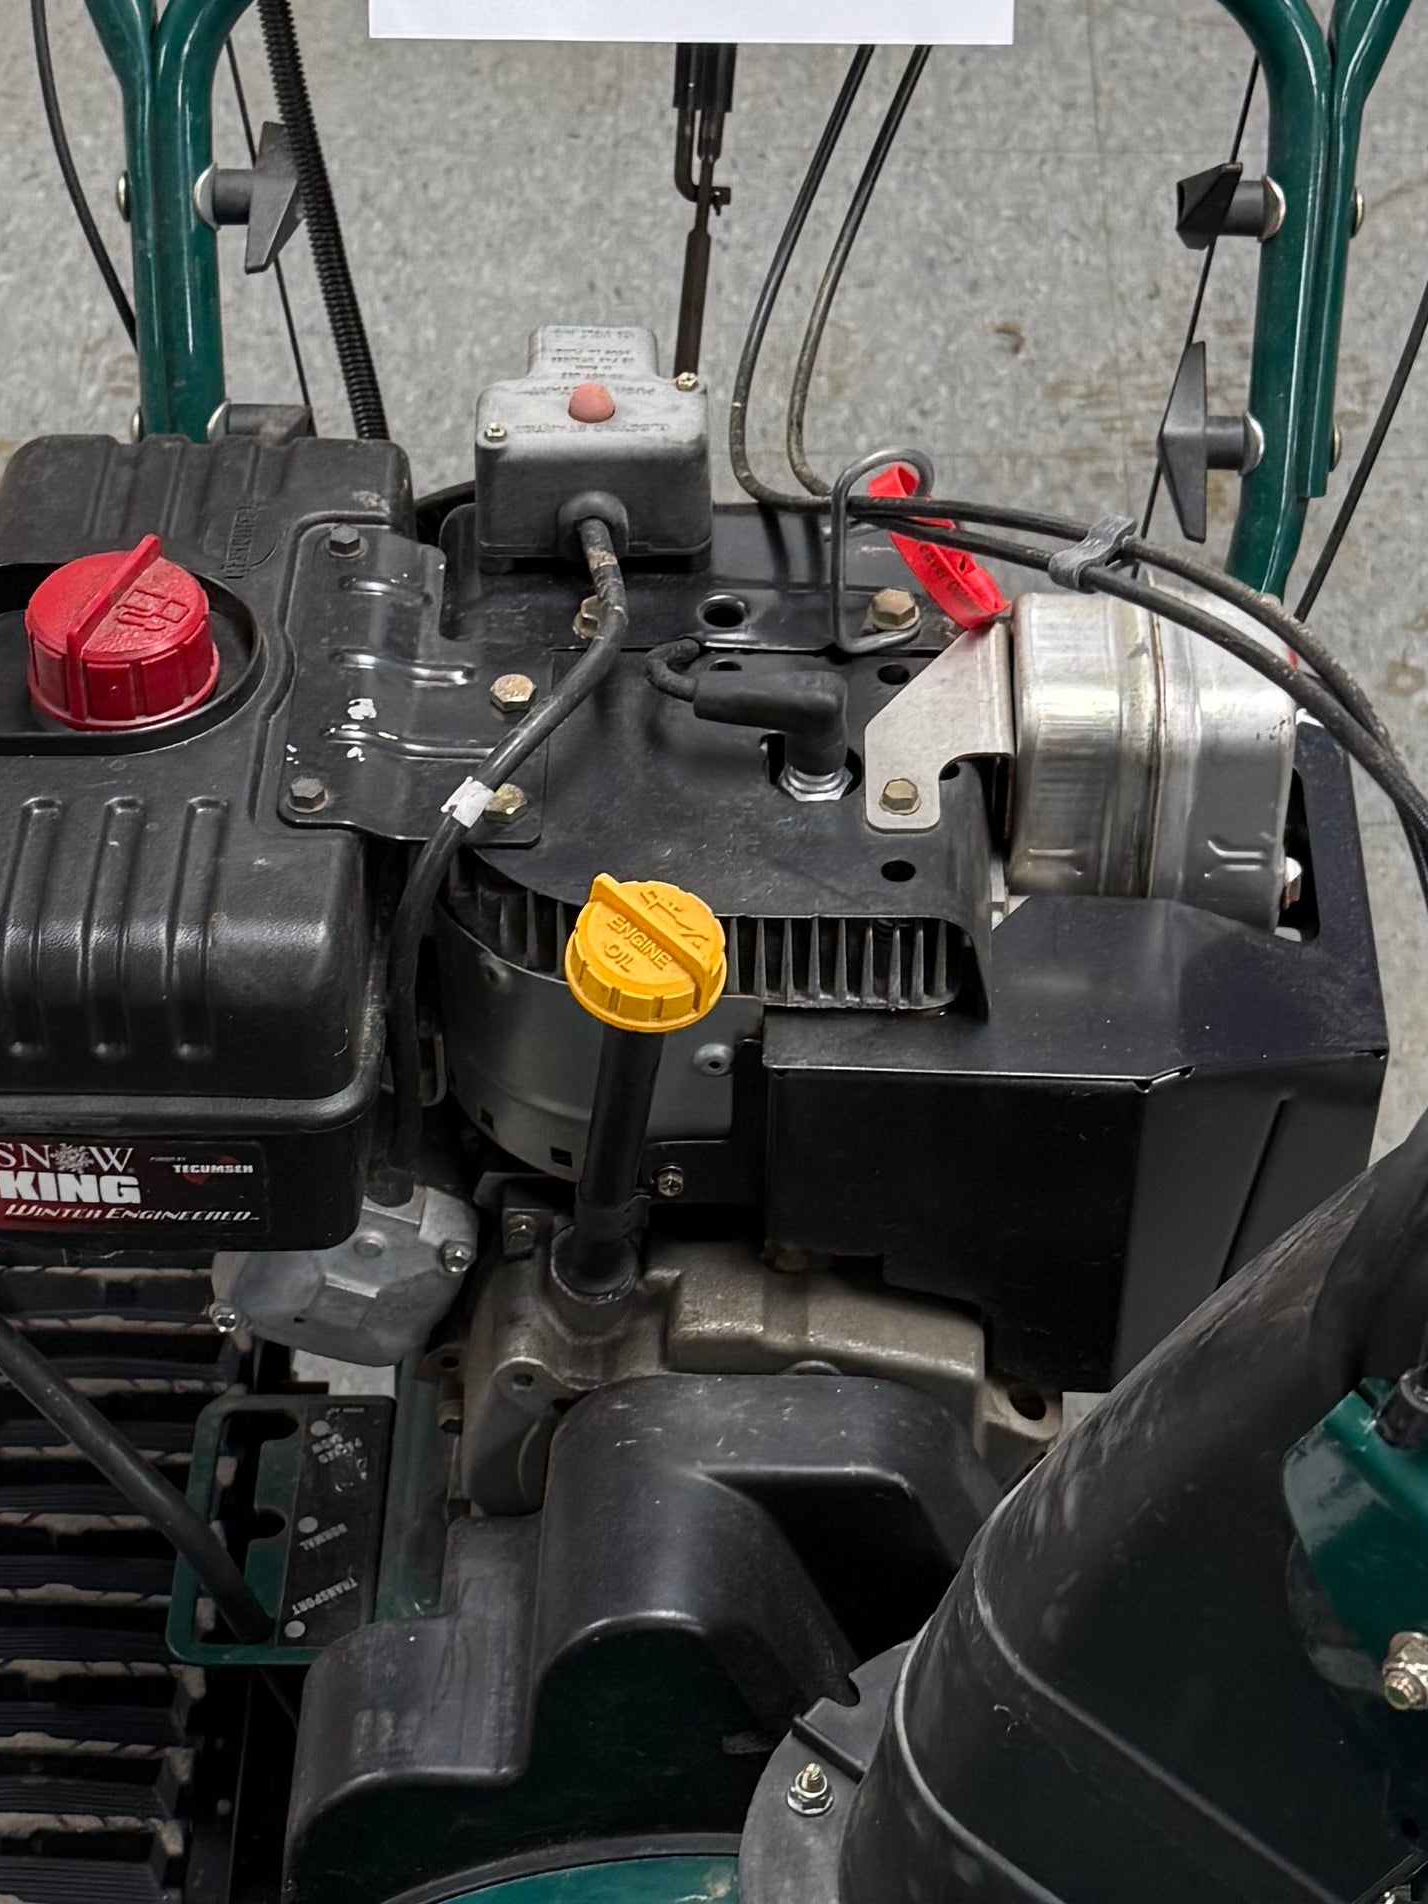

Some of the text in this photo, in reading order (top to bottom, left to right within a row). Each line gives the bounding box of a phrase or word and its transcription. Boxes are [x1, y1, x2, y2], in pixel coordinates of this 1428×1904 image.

[604, 943, 635, 974] OIL
[606, 914, 672, 972] ENGINE
[172, 1164, 253, 1174] TECUMSEH
